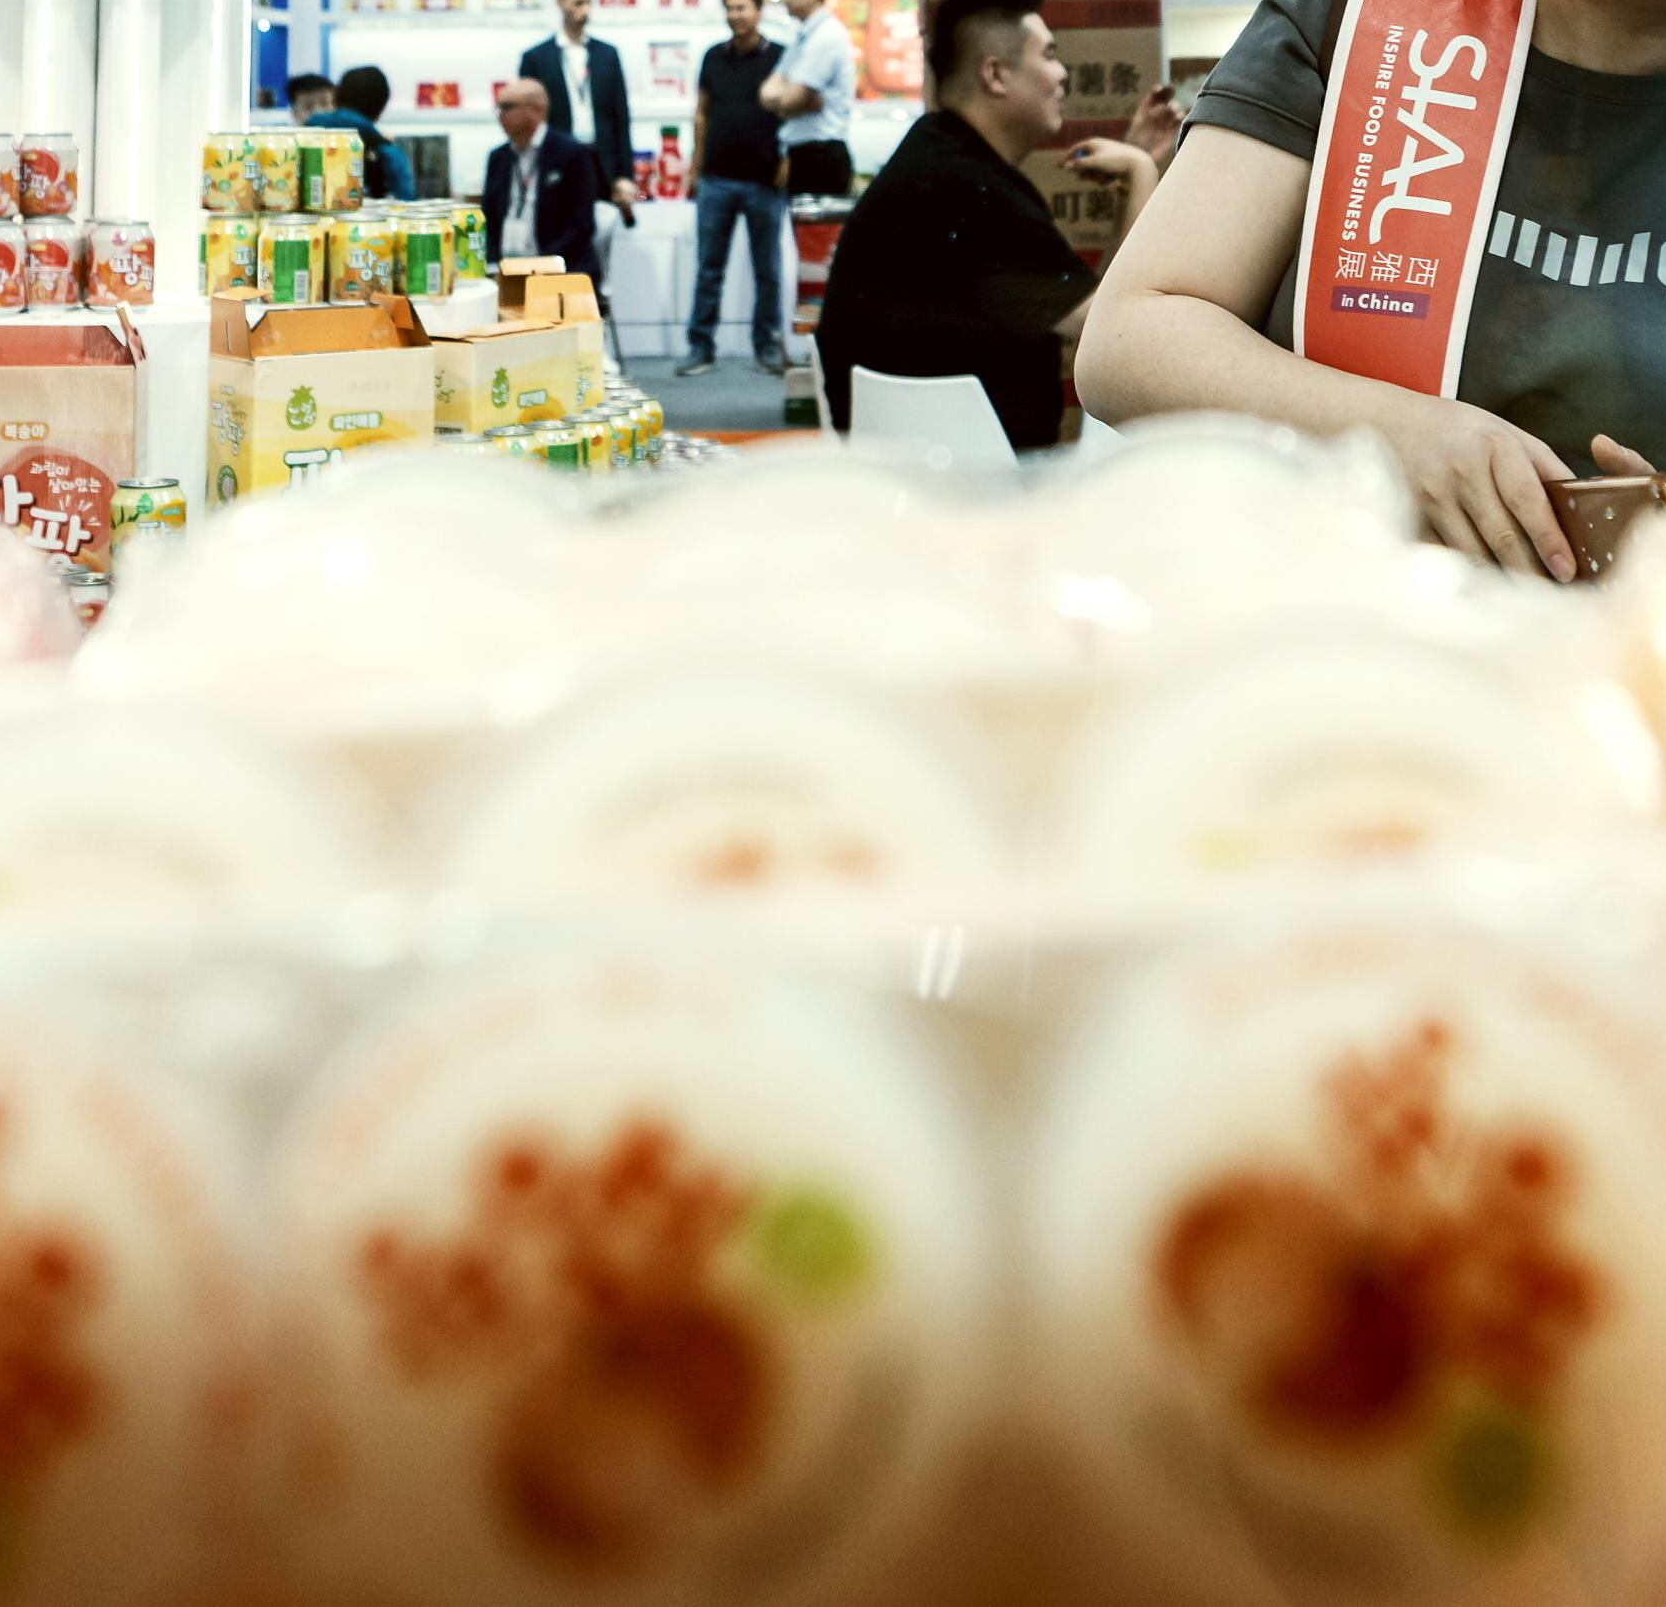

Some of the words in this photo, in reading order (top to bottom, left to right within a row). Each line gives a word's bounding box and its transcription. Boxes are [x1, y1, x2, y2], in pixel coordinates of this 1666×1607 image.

[1373, 24, 1404, 90] INSPIRE
[1360, 94, 1388, 147] FOOD
[1367, 28, 1488, 246] SIAL
[1341, 152, 1375, 243] BUSINESS
[1340, 294, 1354, 308] in
[1357, 292, 1415, 315] China
